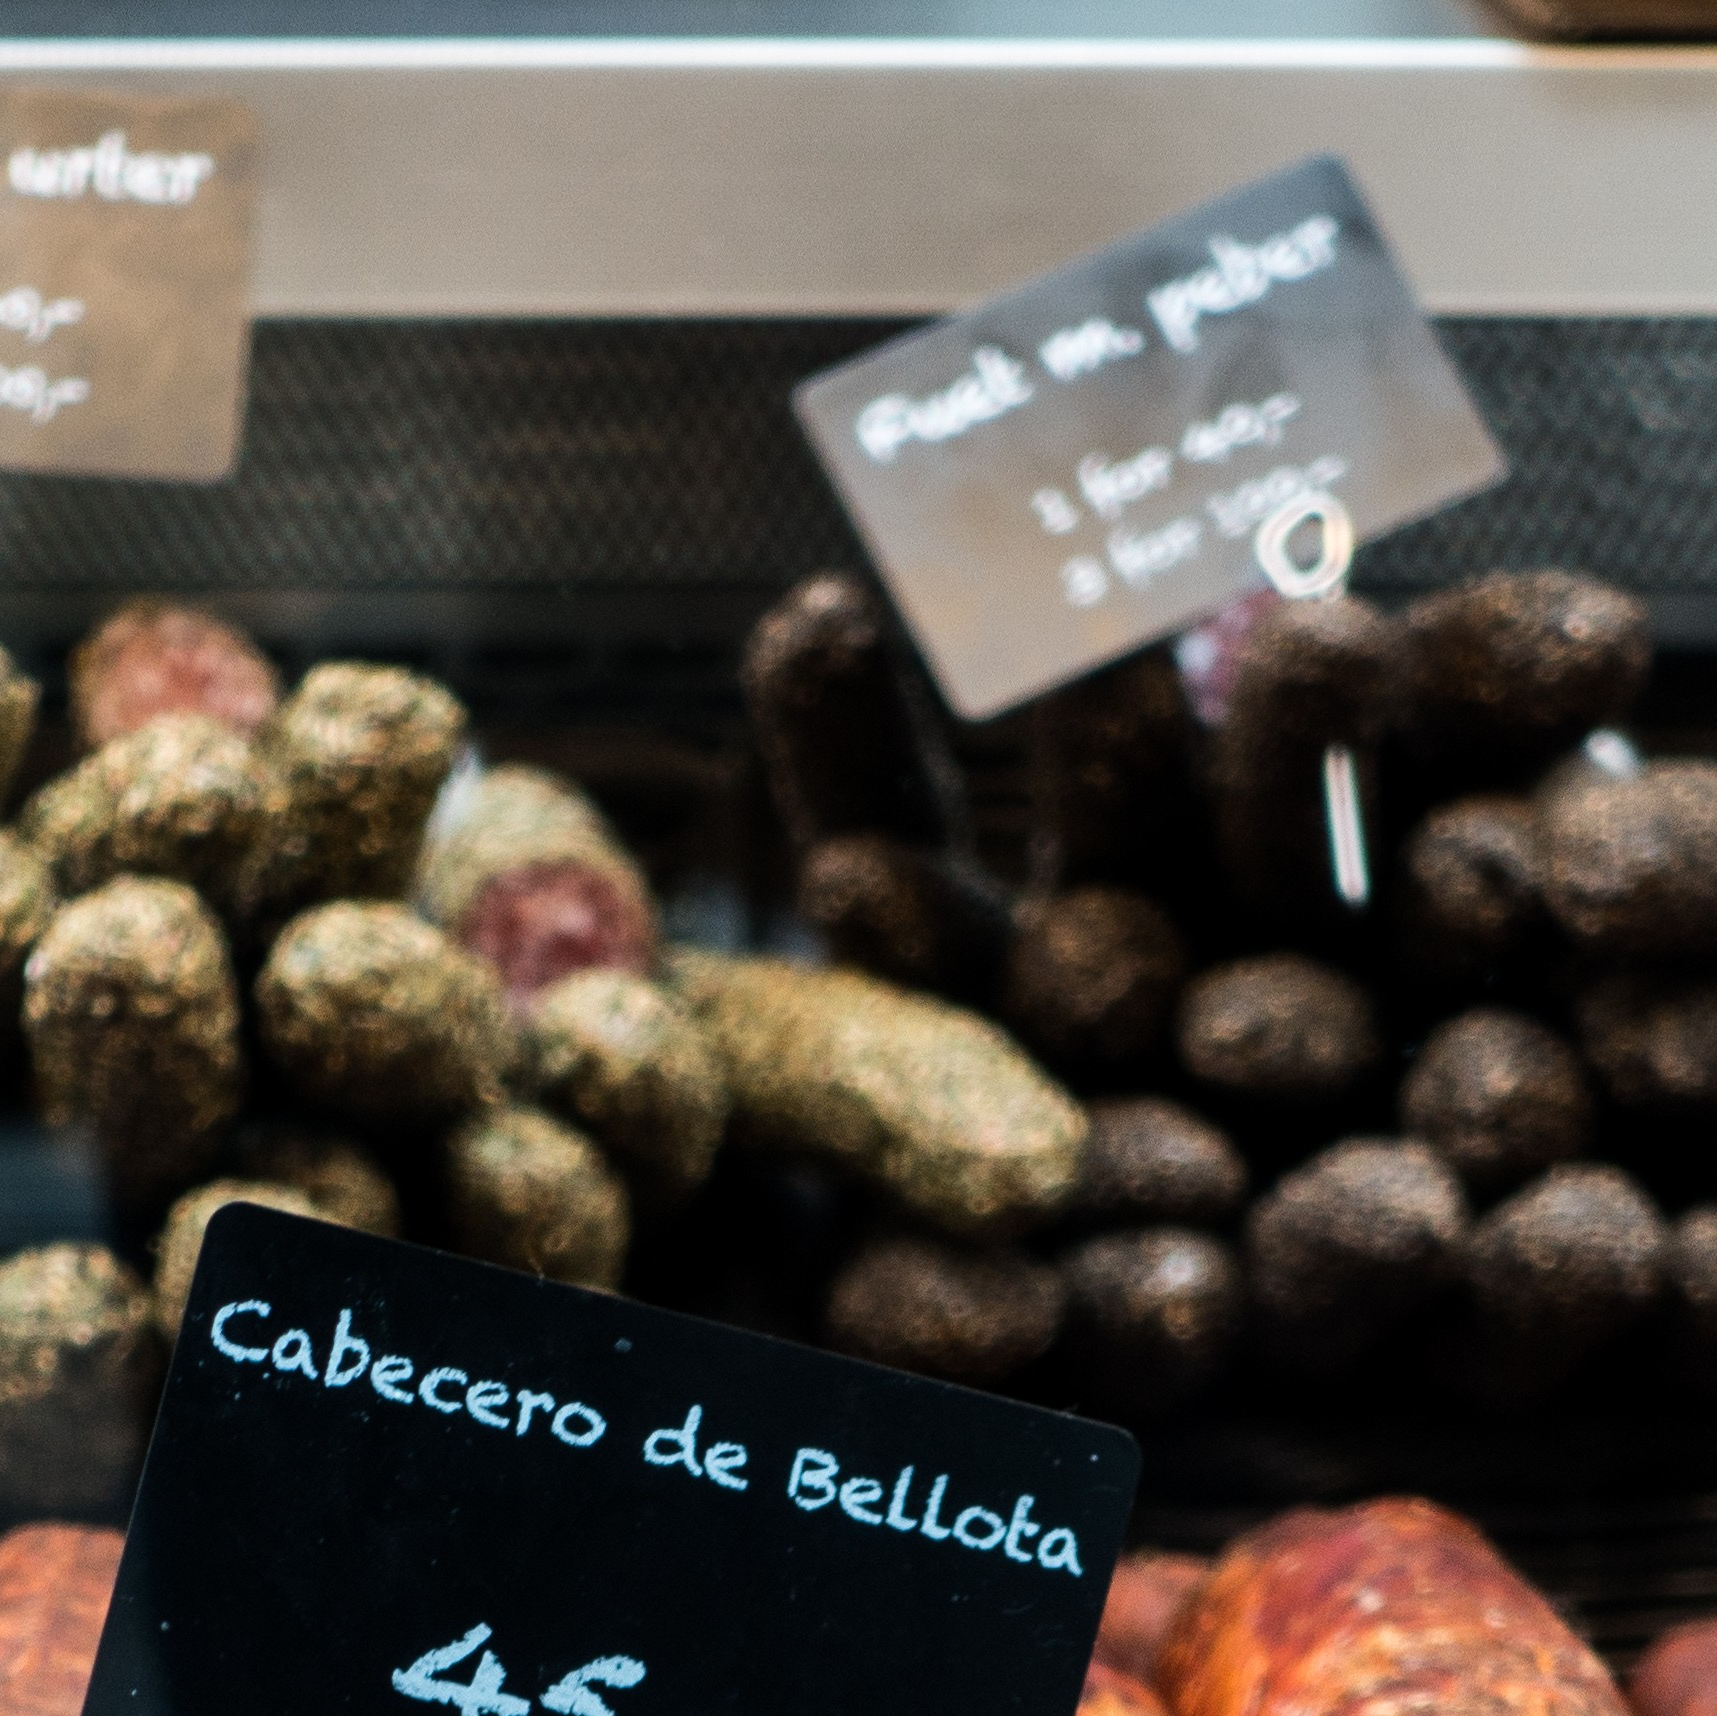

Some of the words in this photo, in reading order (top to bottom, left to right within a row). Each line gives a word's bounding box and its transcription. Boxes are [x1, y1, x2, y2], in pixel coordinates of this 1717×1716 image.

[1042, 320, 1142, 380] m.
[212, 1300, 605, 1444] Cabecero
[645, 1406, 746, 1488] de
[789, 1449, 1080, 1573] Bellota
